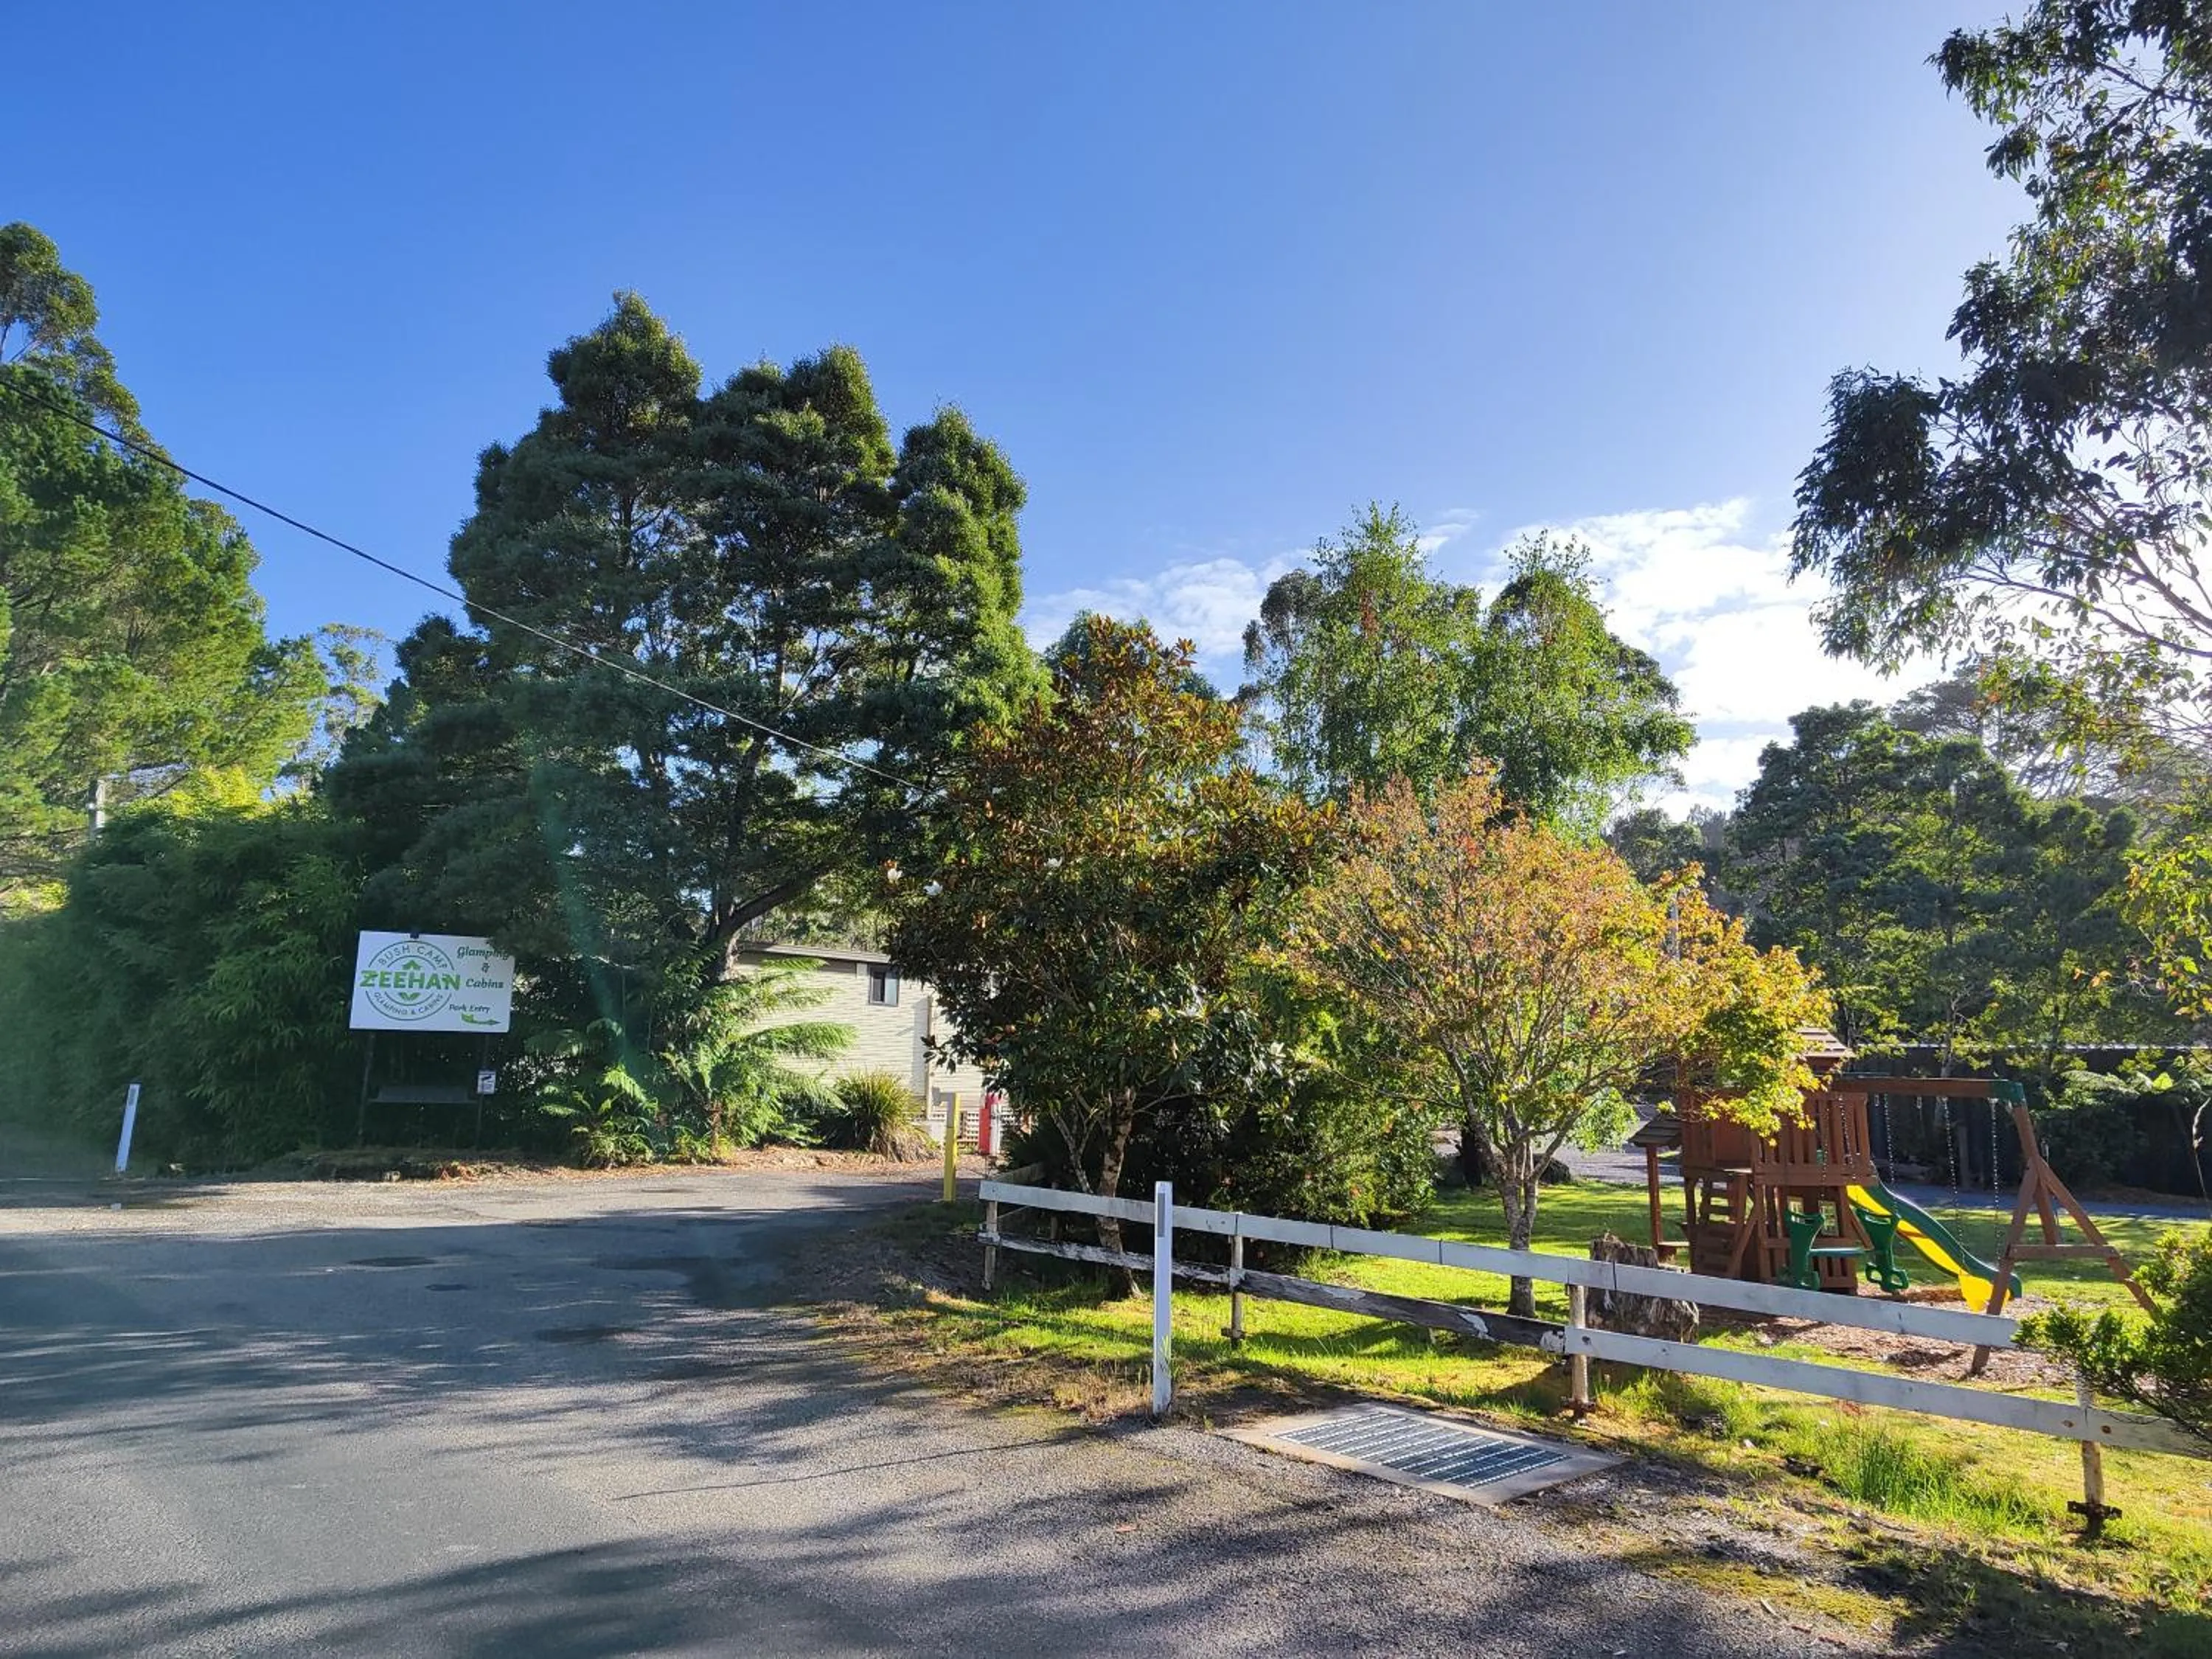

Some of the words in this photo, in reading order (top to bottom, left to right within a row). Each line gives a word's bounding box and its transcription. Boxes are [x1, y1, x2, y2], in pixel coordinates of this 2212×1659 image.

[378, 945, 411, 966] BUSH
[417, 946, 448, 969] CAMP
[456, 946, 509, 961] Glamping
[481, 962, 490, 973] &
[360, 970, 461, 991] ZEEHAN
[465, 978, 505, 989] Cabins
[448, 1004, 467, 1012] Park
[468, 1004, 490, 1015] Entry
